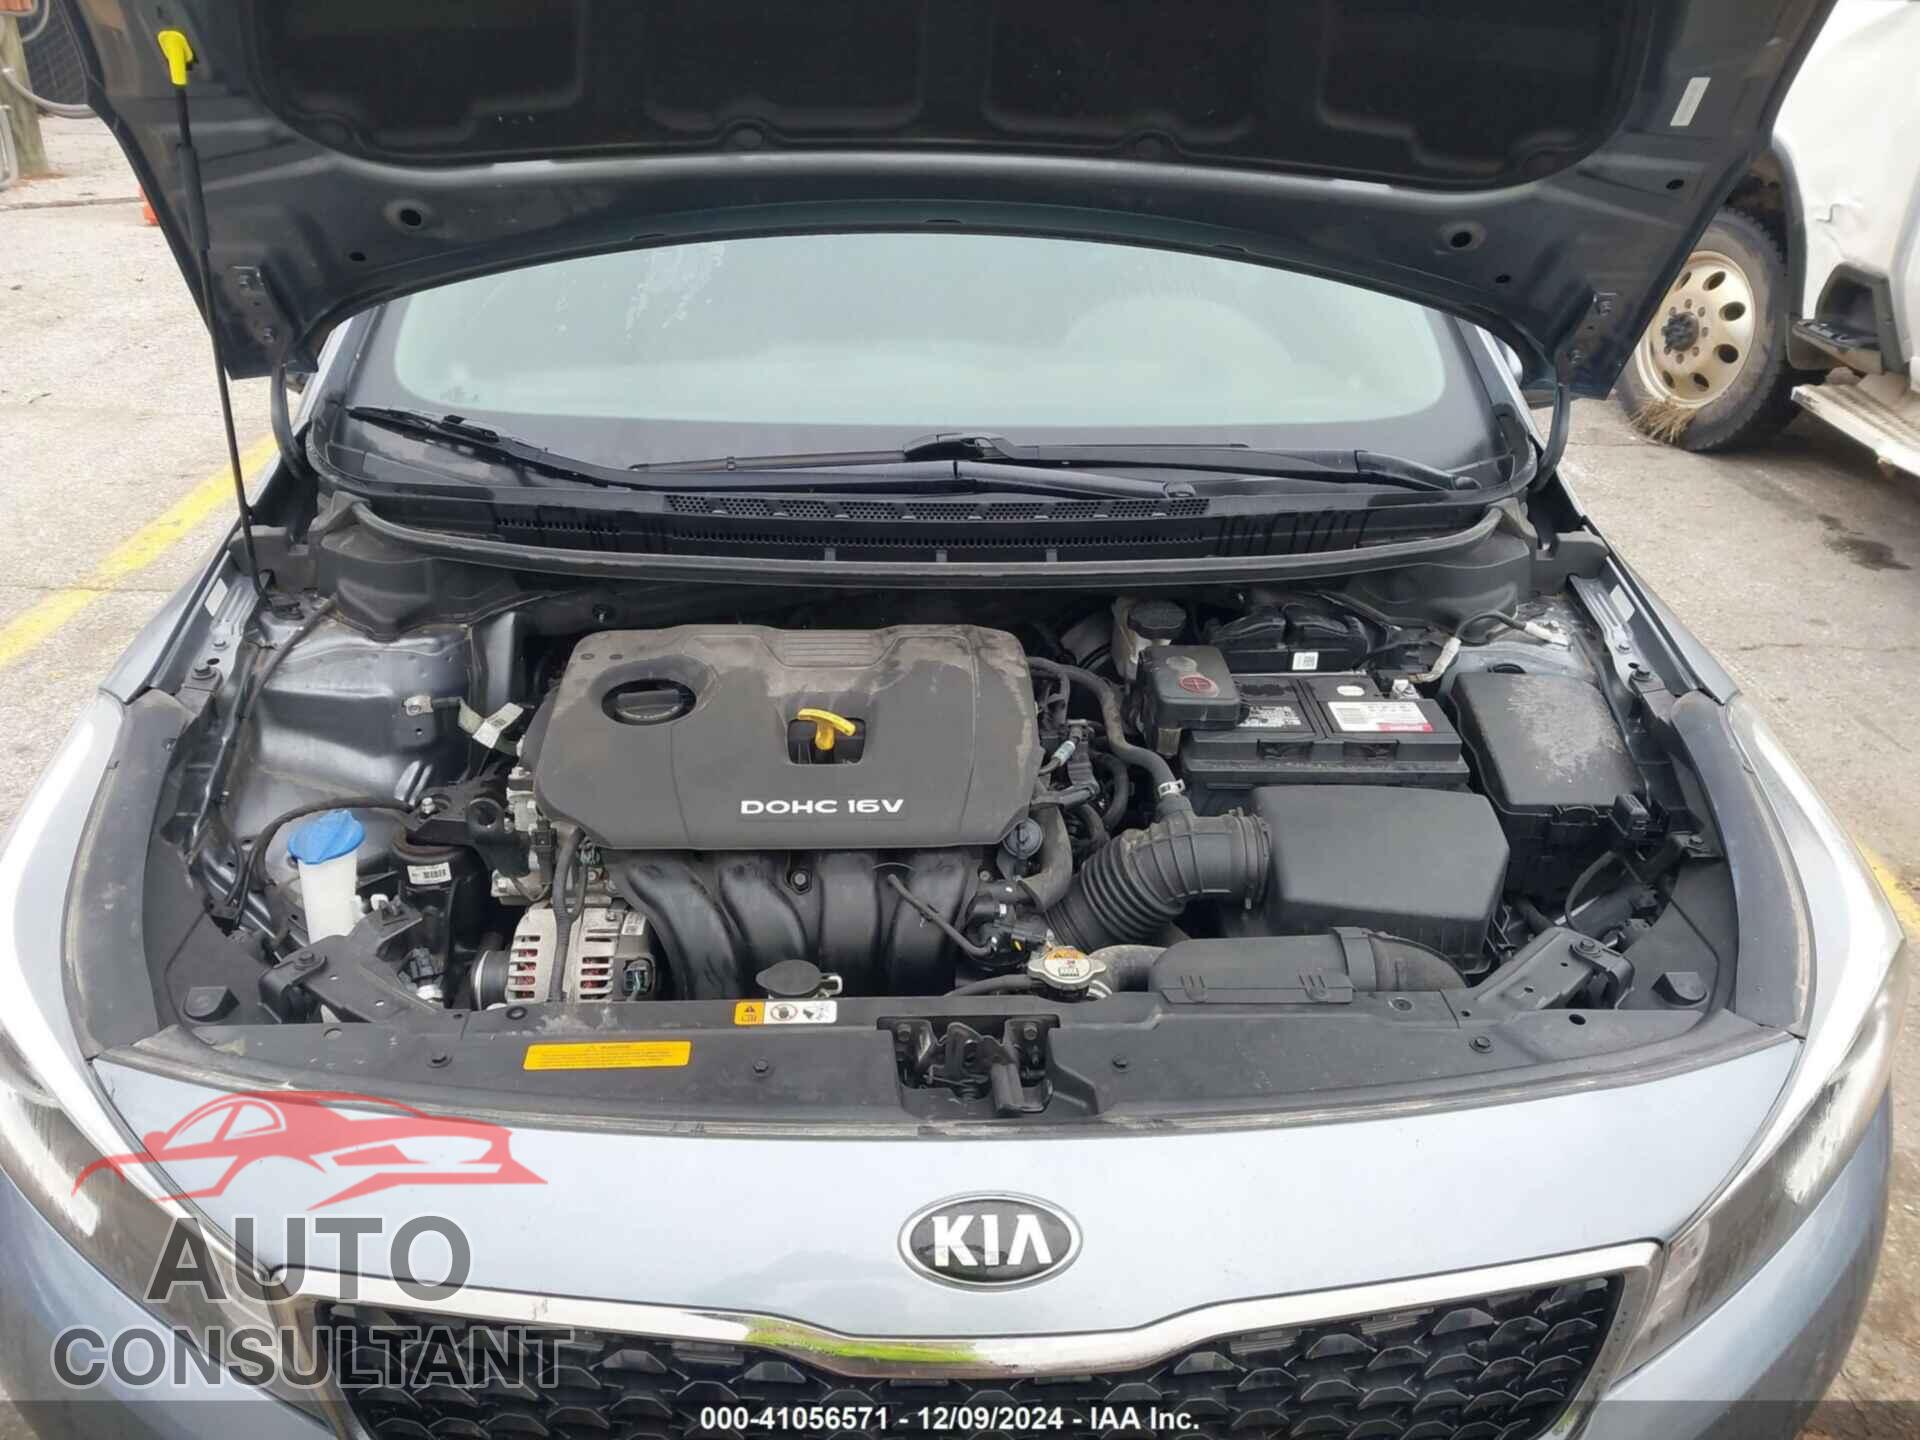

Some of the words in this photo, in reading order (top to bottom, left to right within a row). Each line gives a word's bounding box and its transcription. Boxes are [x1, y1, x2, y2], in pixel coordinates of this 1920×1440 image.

[740, 799, 838, 814] DOHC
[847, 799, 904, 813] 16V
[931, 1214, 1053, 1267] KIA
